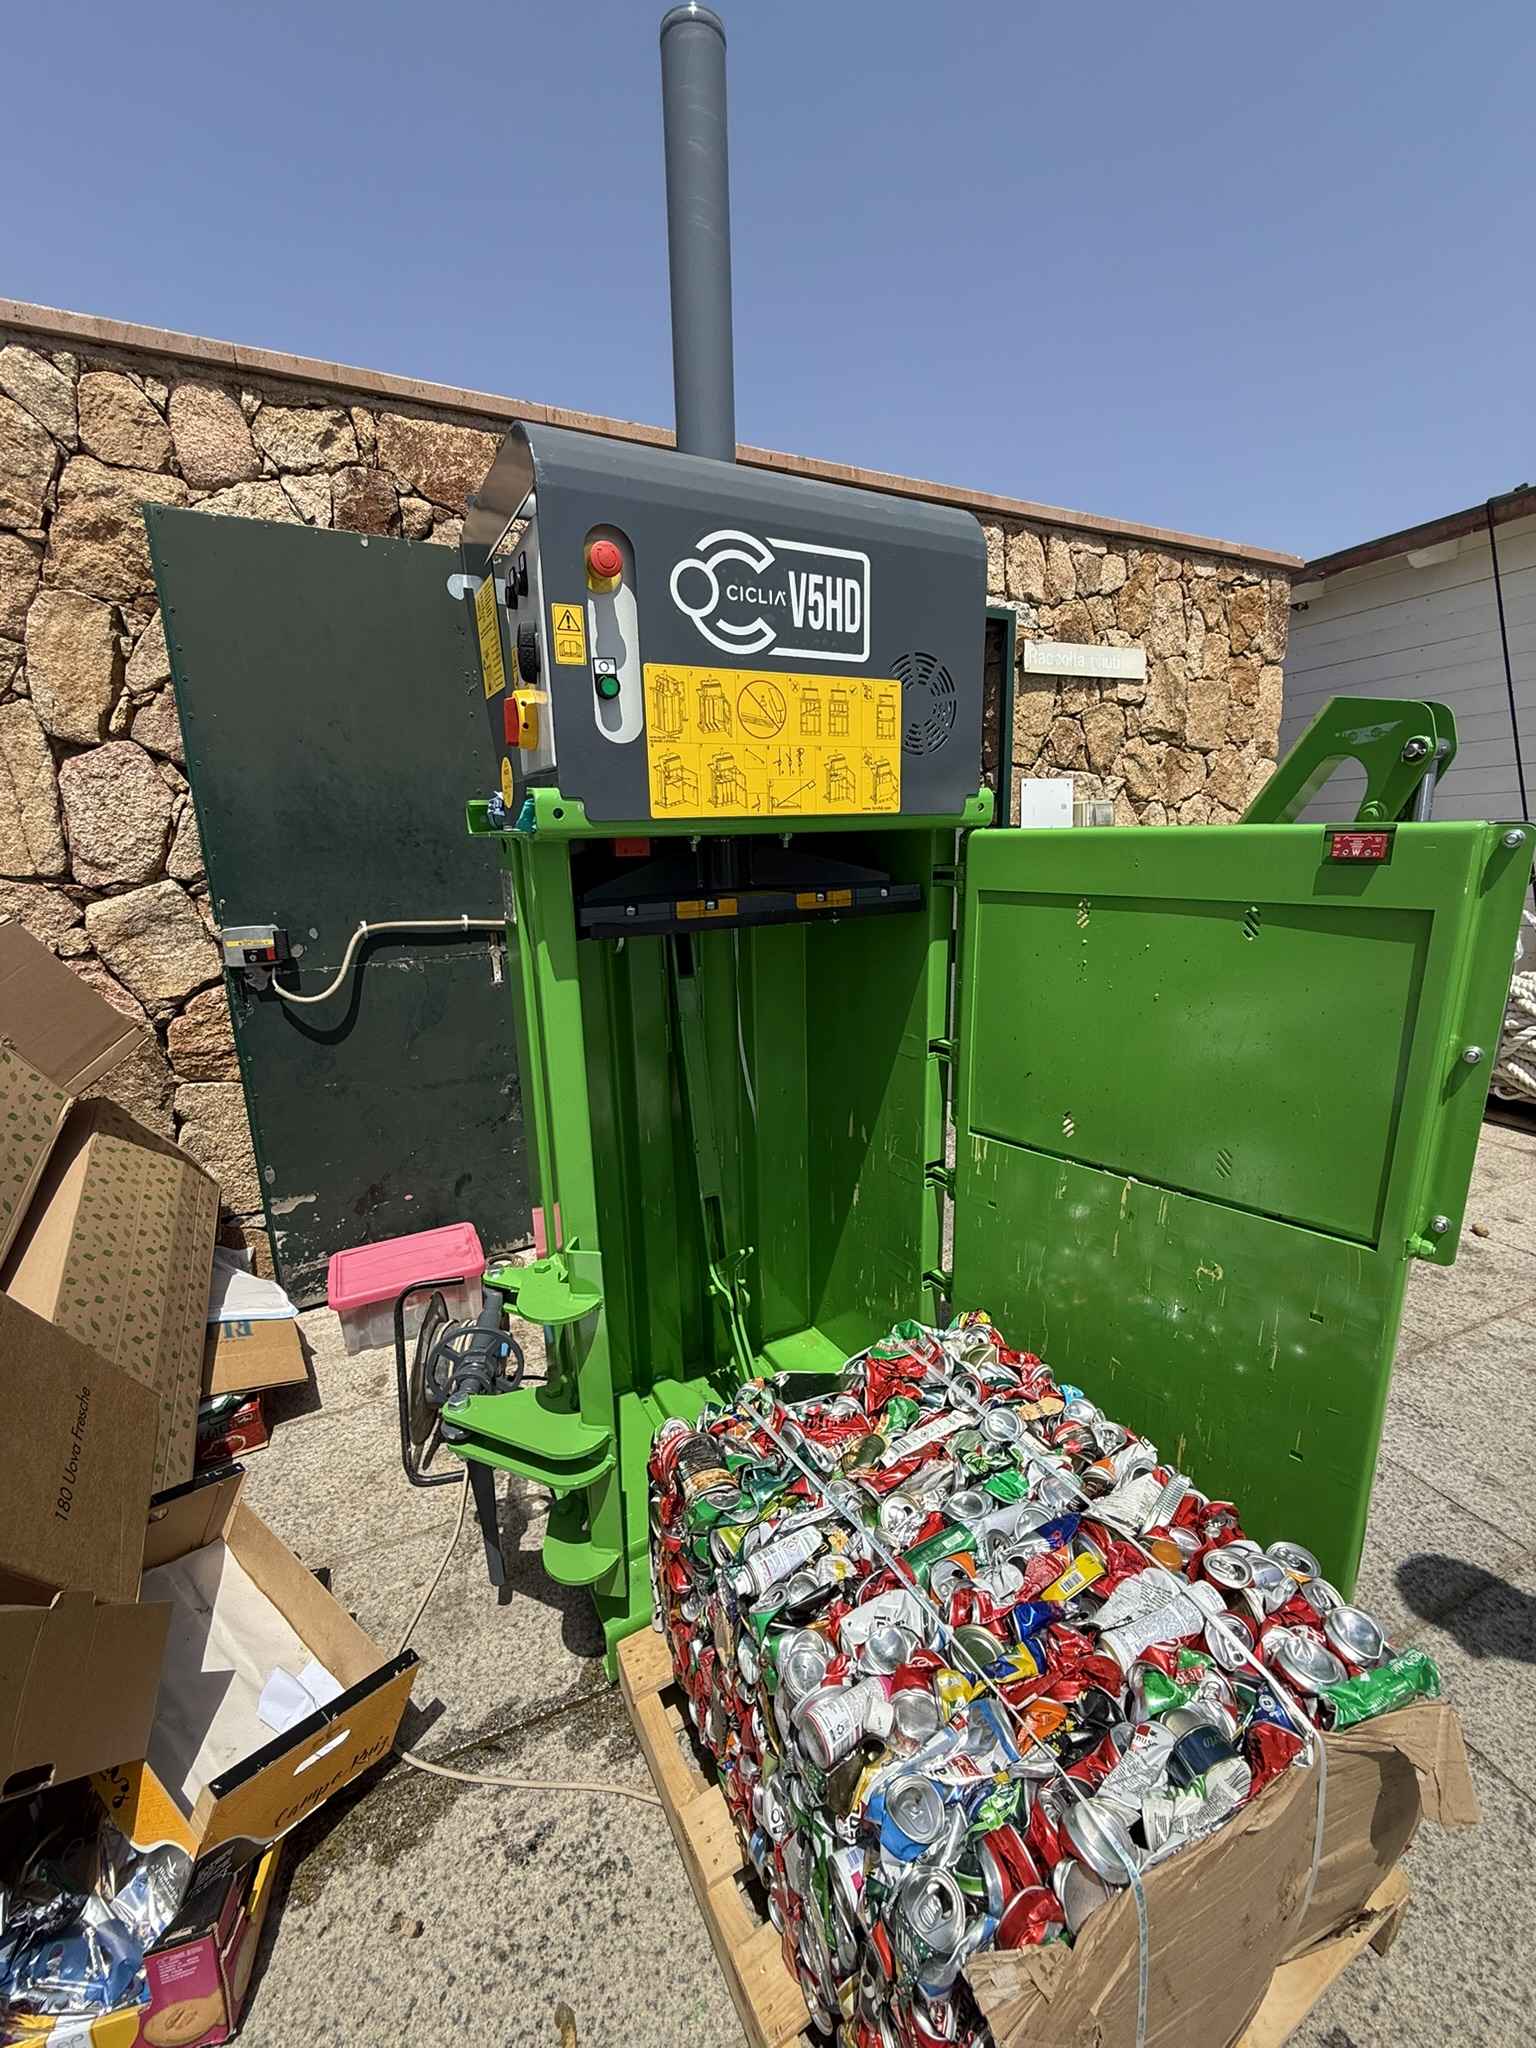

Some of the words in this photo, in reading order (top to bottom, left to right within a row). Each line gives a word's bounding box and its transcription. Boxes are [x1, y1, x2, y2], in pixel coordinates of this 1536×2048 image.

[788, 570, 862, 633] V5HD
[71, 1386, 91, 1441] Fresche
[63, 1442, 81, 1485] Uova
[54, 1486, 73, 1521] 180
